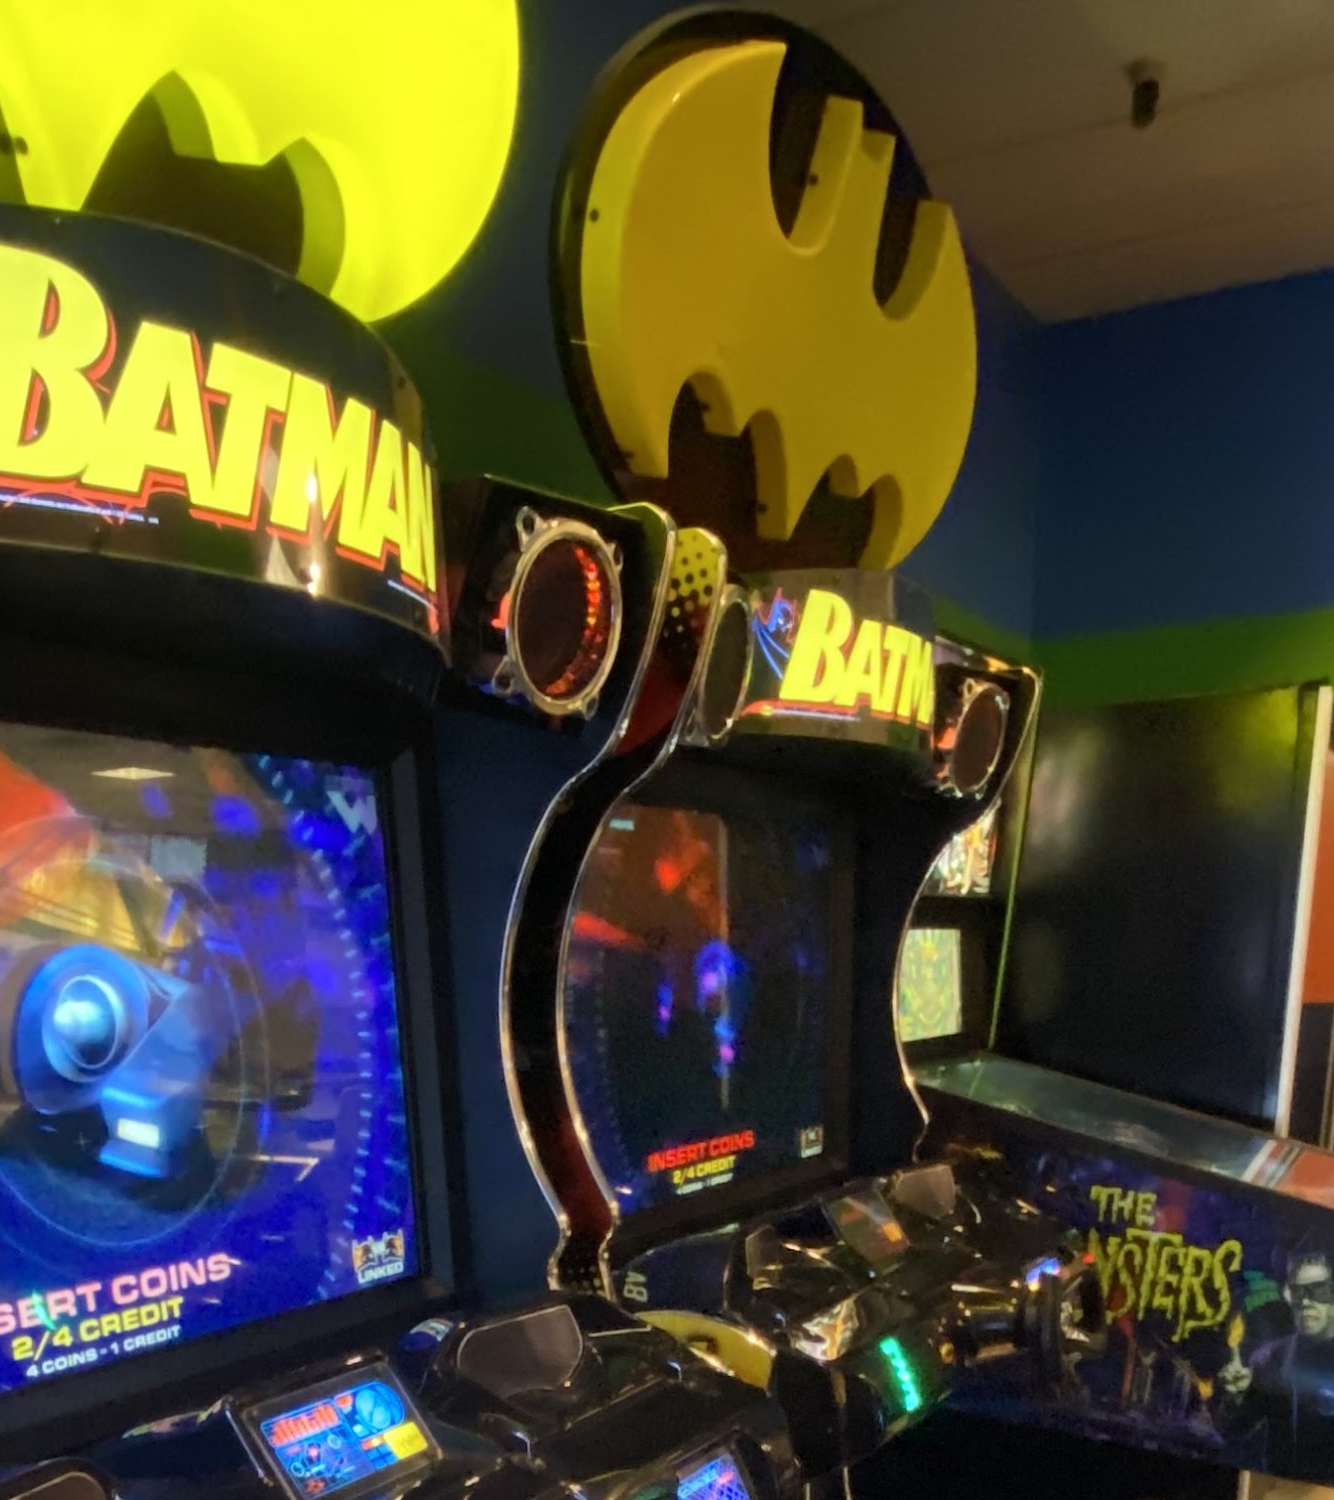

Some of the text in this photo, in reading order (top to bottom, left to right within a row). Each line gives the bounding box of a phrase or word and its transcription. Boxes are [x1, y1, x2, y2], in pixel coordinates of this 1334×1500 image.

[647, 1129, 756, 1173] INSERT COINS
[672, 1166, 695, 1185] 2/4
[695, 1154, 737, 1178] CREDIT
[1089, 1184, 1158, 1227] THE
[110, 1252, 233, 1306] COINS
[358, 1260, 404, 1284] LINKED
[10, 1296, 184, 1362] 2/4 CREDIT
[25, 1364, 39, 1377] 4
[41, 1348, 98, 1374] COINS
[110, 1342, 119, 1355] 1
[123, 1324, 181, 1352] CREDIT
